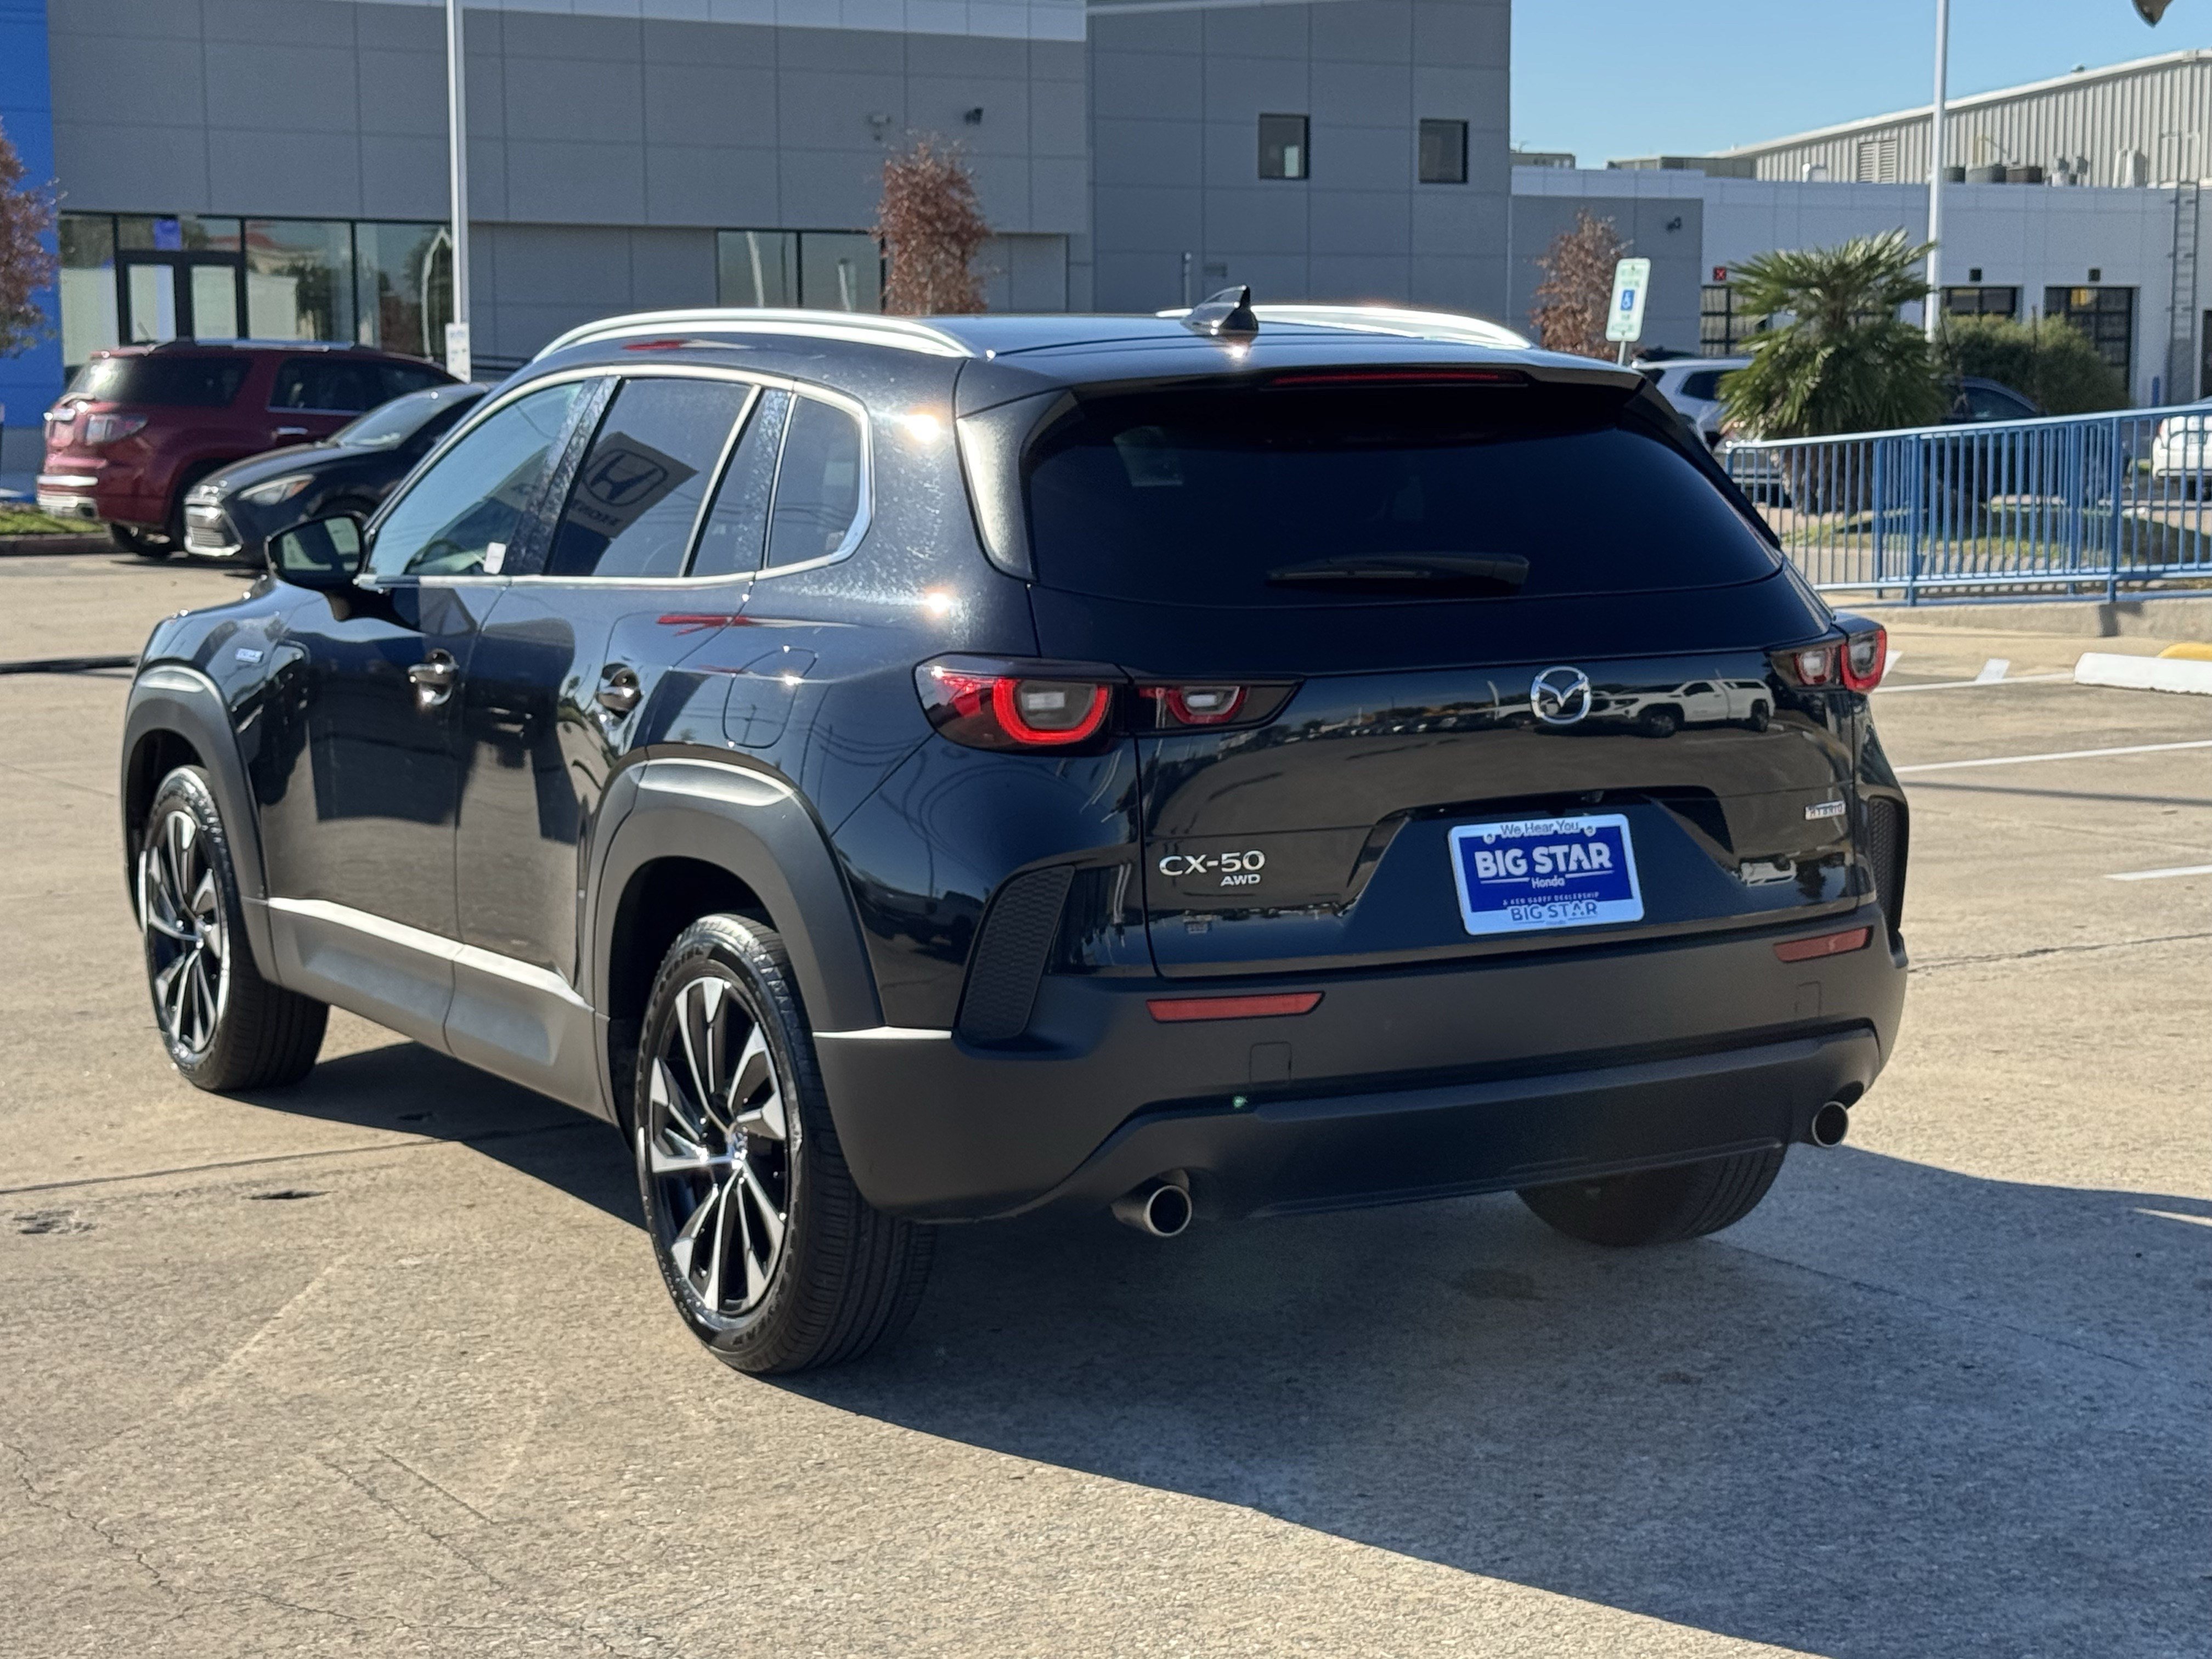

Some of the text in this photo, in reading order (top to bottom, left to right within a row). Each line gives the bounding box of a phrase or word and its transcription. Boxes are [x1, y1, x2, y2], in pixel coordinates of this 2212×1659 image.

[1500, 819, 1579, 836] We Hear You
[1159, 850, 1266, 876] CX-50
[1474, 842, 1613, 878] BIG STAR
[1220, 873, 1261, 887] AWD
[1531, 874, 1566, 889] Honda
[1510, 901, 1598, 921] BIG STAR
